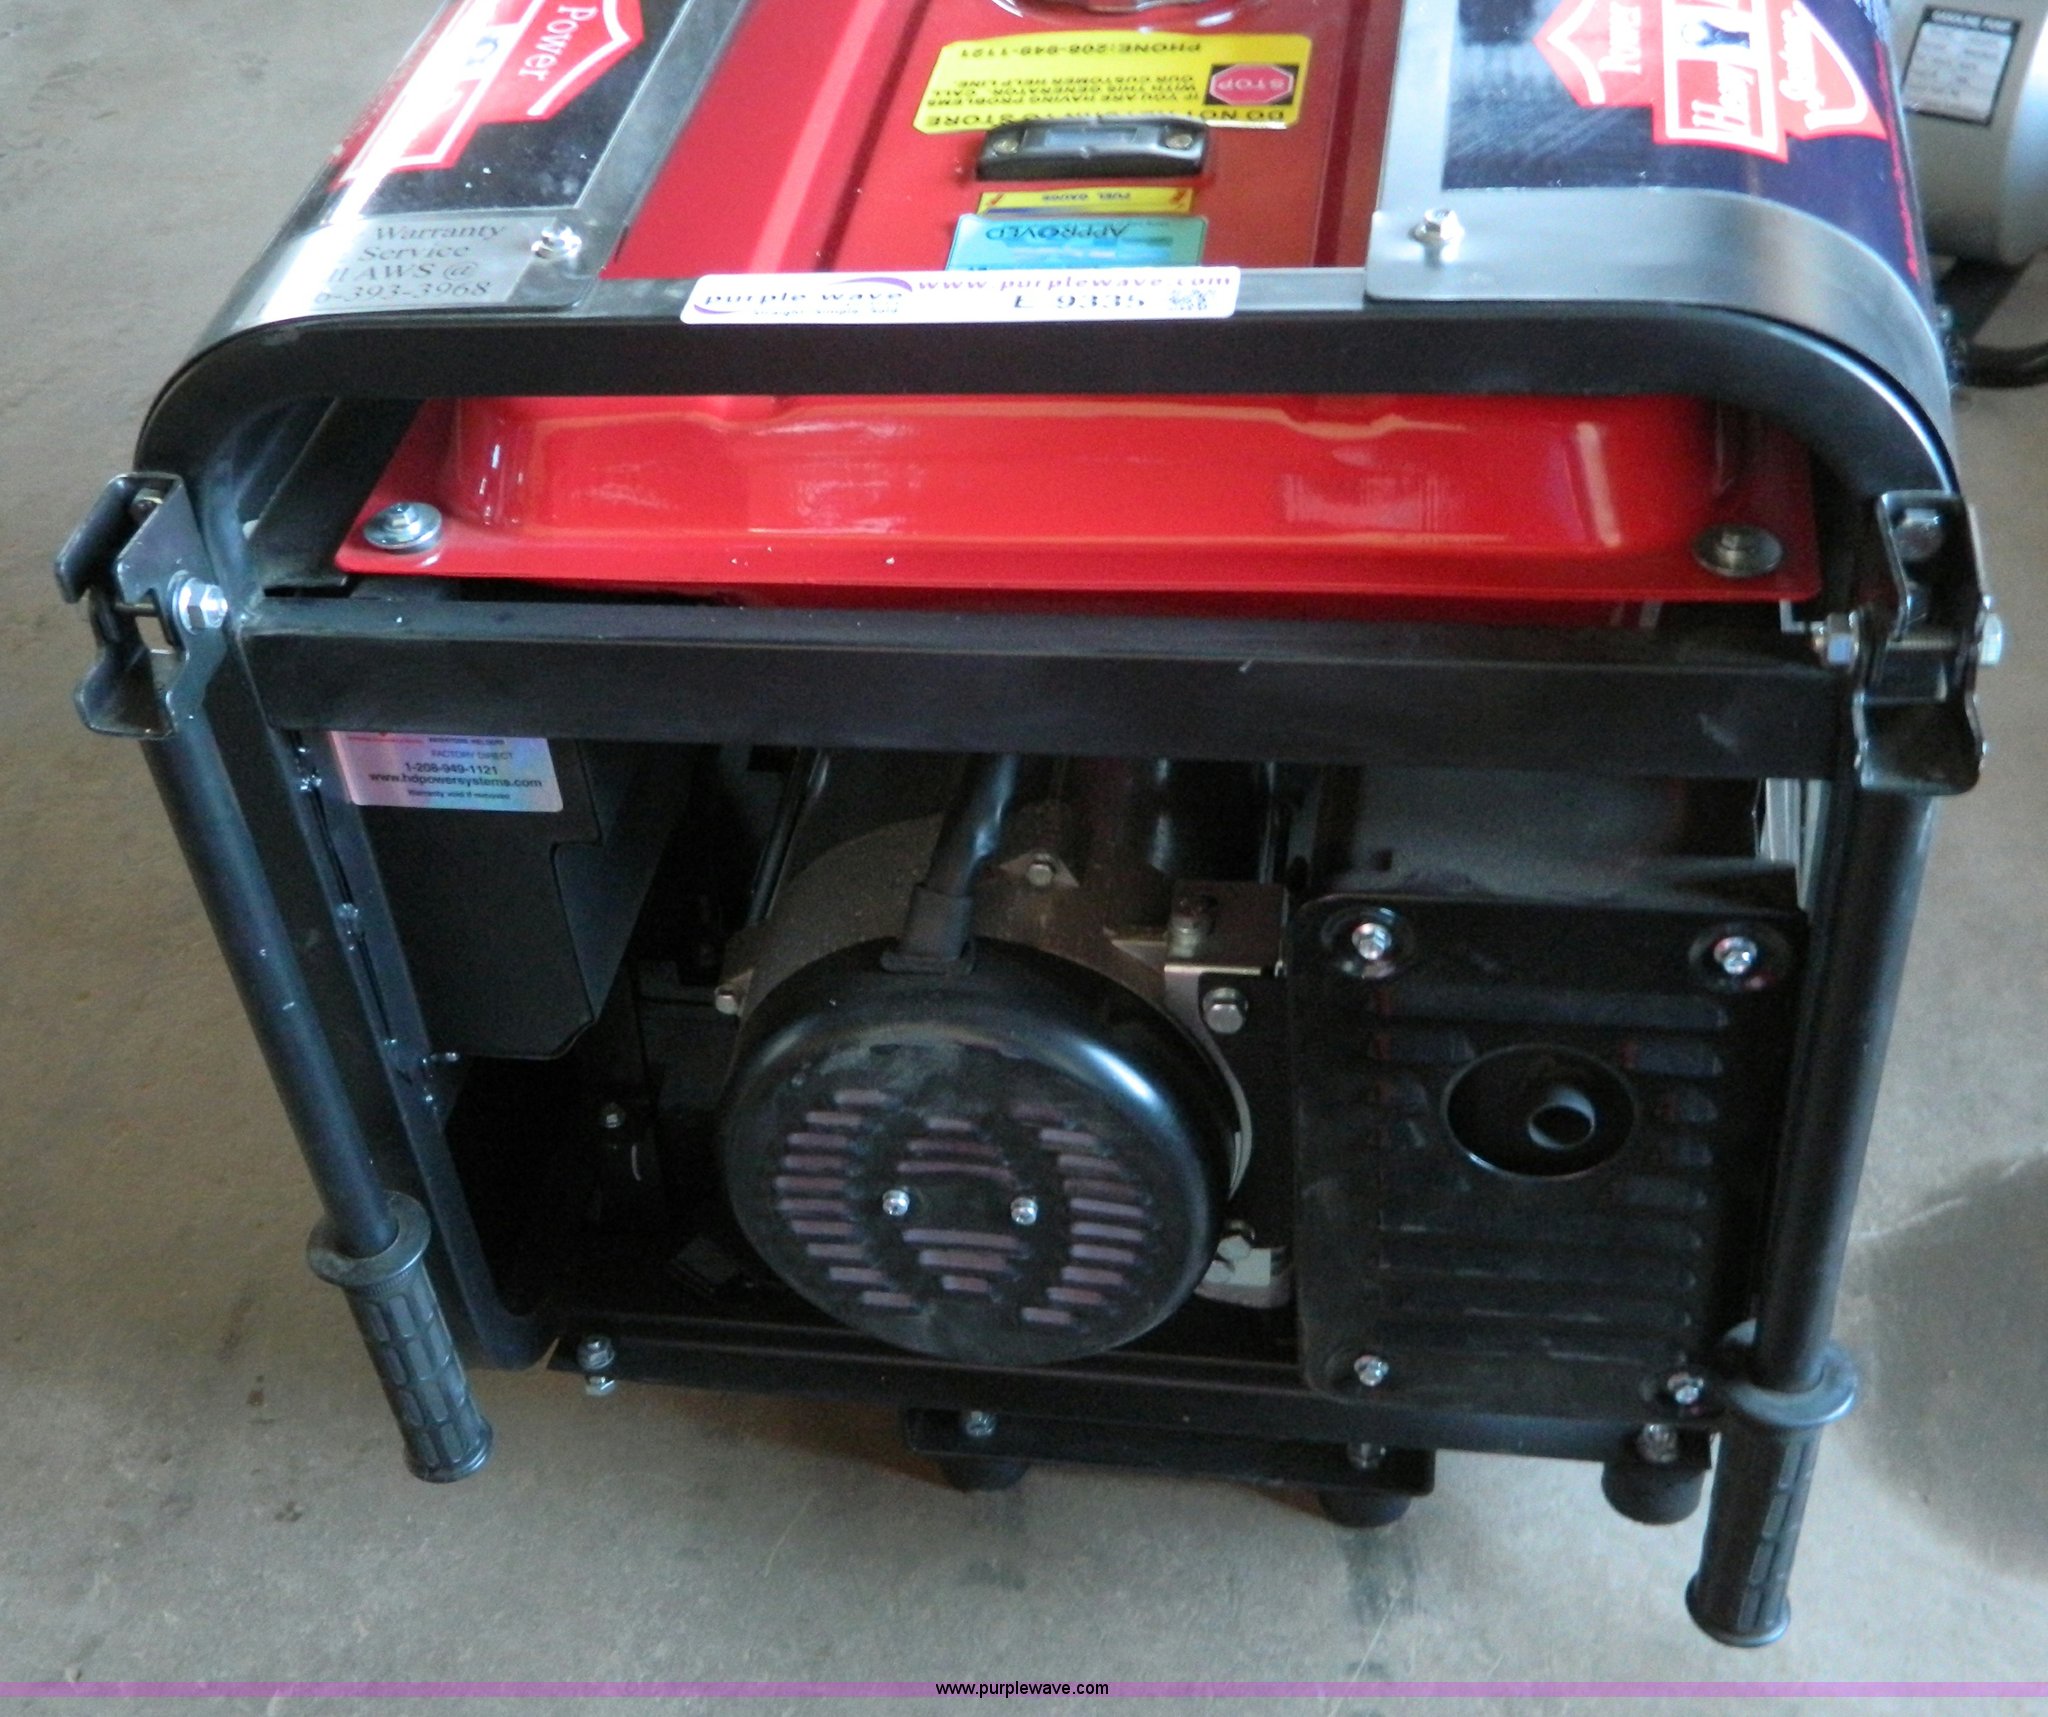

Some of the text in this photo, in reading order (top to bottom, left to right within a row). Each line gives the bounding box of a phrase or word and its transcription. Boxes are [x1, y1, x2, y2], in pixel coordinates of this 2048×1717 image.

[518, 4, 598, 82] Power
[1215, 77, 1286, 93] STOP
[1246, 109, 1285, 122] DO
[1041, 192, 1131, 203] FUEL GAUGE
[376, 225, 505, 241] Warranty
[985, 223, 1130, 241] APPROVED
[357, 243, 471, 261] Service
[353, 262, 437, 280] AWS
[441, 260, 481, 280] @
[704, 291, 904, 306] purple wave
[404, 761, 499, 776] 1-208-949-1121
[368, 773, 543, 788] www.hdpowersystems.com
